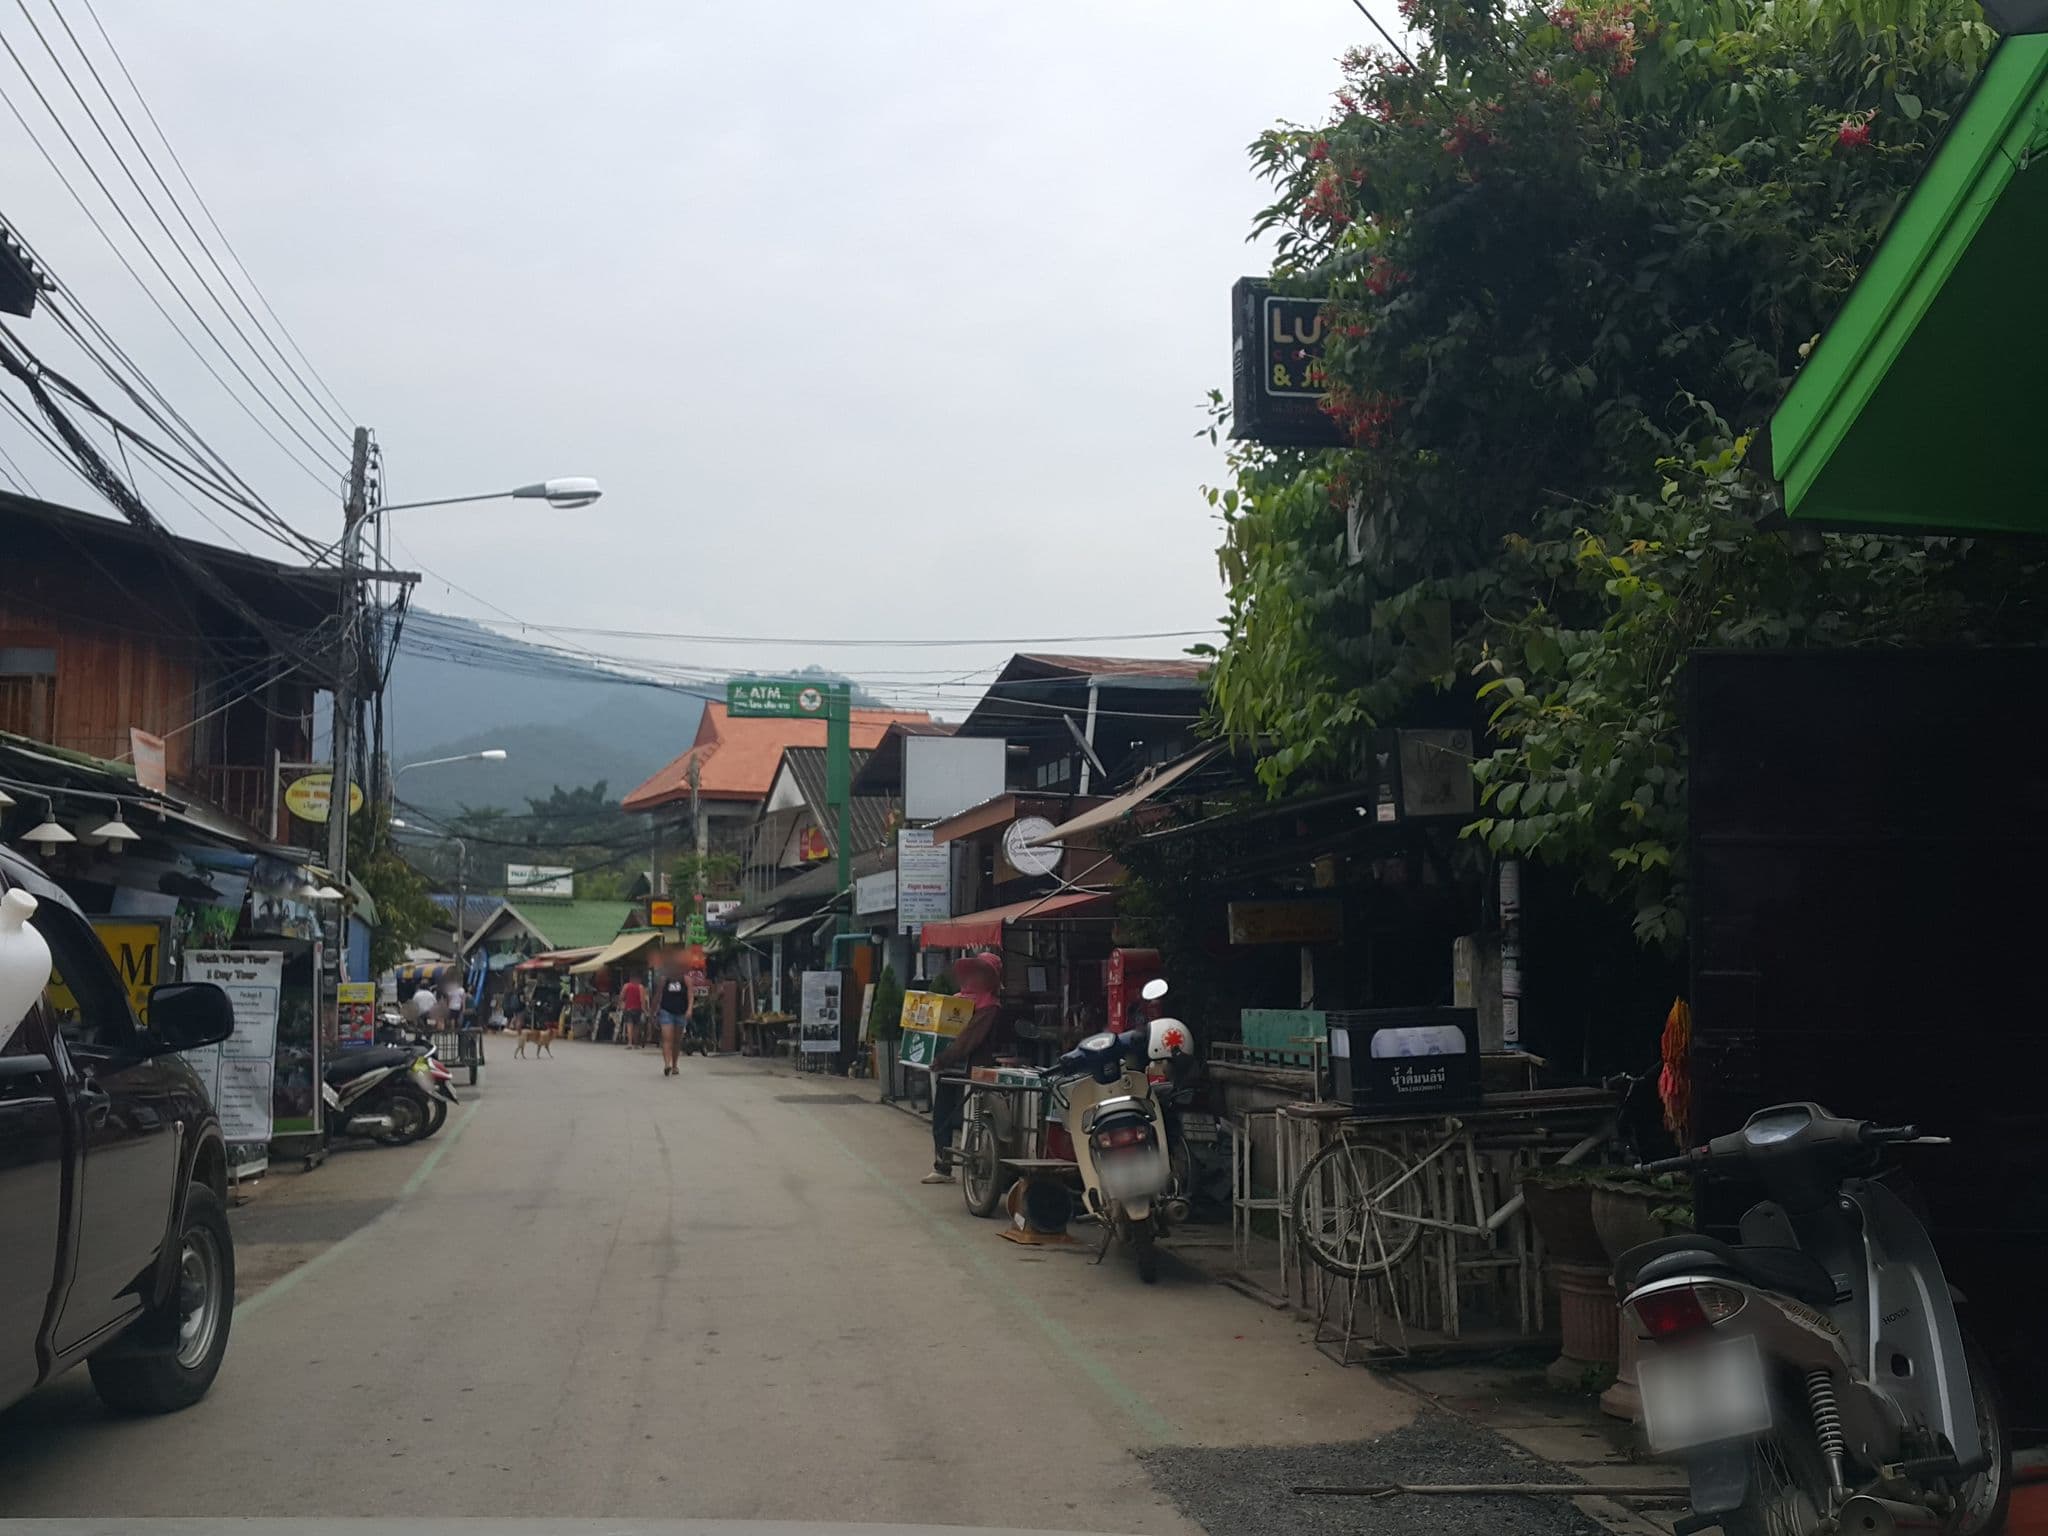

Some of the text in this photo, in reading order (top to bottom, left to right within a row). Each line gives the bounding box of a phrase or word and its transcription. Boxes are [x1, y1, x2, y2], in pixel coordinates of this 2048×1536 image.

[1273, 308, 1324, 345] LU
[750, 686, 781, 700] ATM
[214, 969, 232, 982] Day
